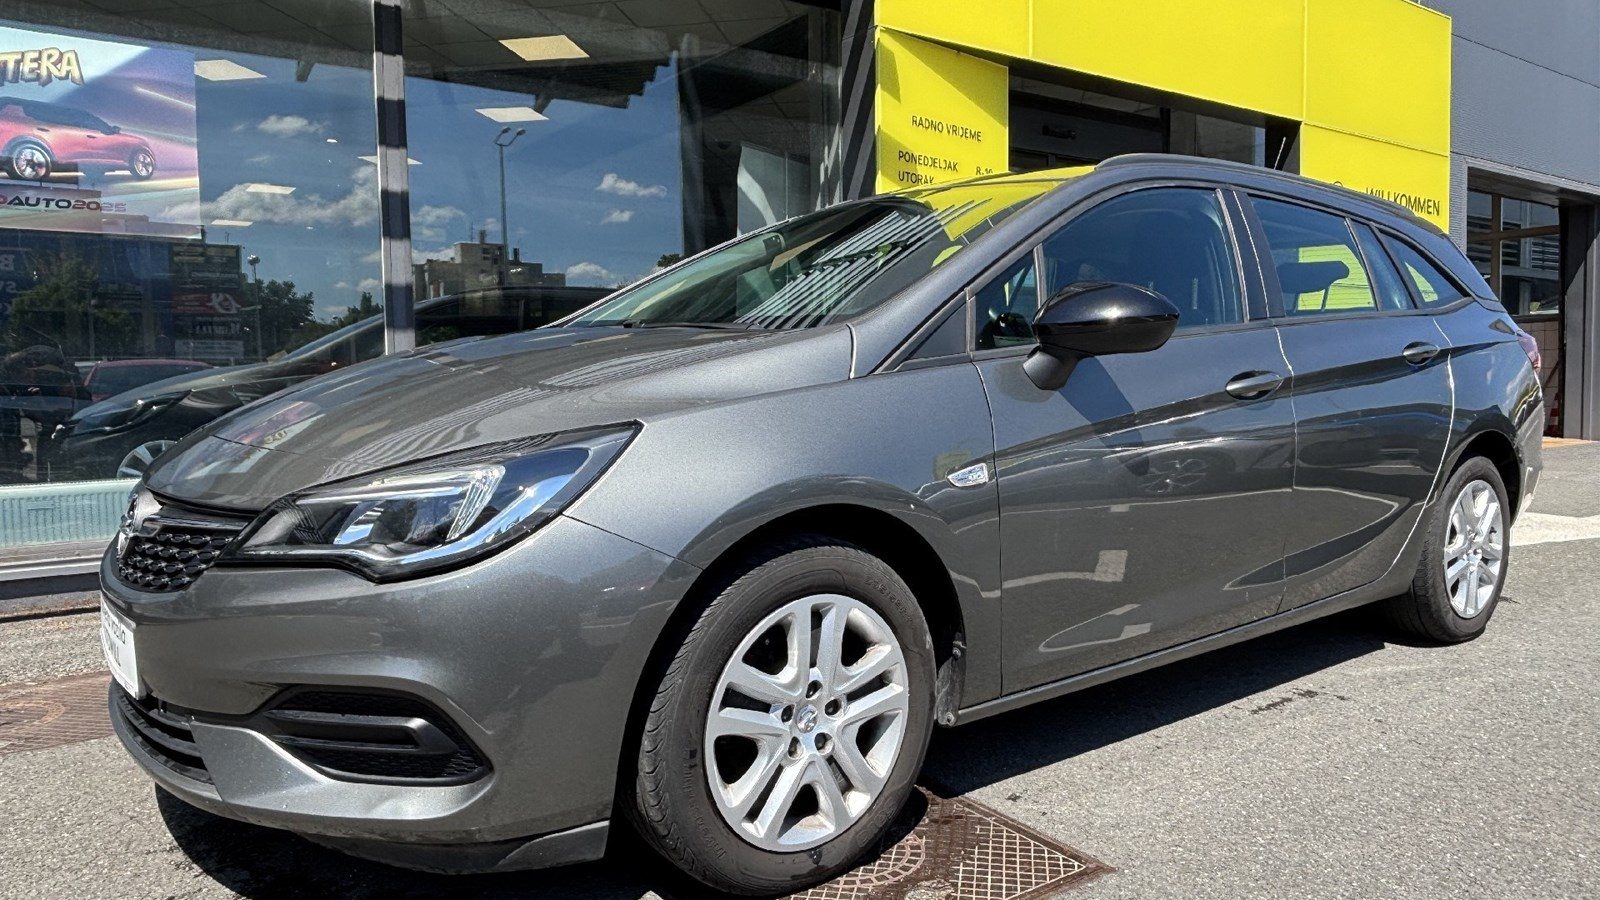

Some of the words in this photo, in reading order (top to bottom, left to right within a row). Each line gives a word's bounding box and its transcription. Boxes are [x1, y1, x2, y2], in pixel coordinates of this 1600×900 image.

[0, 47, 85, 87] TERA
[911, 115, 944, 133] RADNO
[946, 123, 982, 142] VRIJEME
[898, 150, 959, 172] PONEDJELJAK
